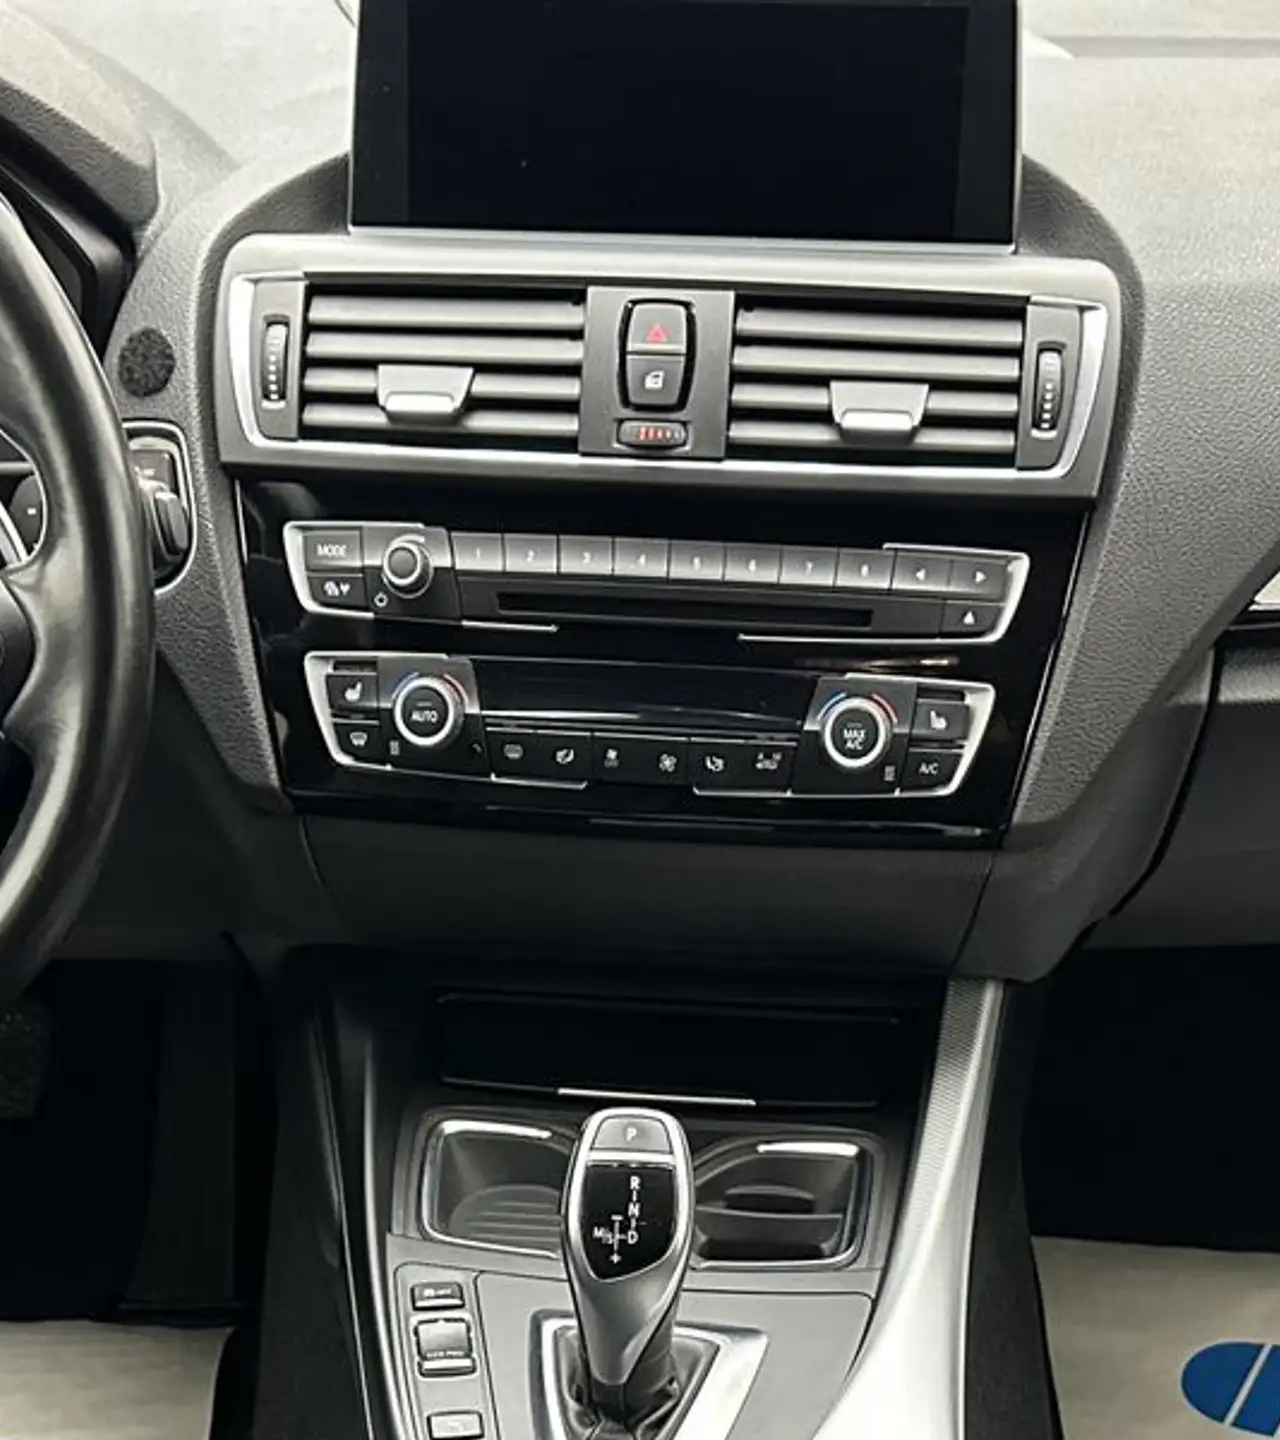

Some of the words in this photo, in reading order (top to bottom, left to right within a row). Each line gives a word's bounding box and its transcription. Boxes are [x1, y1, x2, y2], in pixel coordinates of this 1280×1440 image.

[316, 543, 347, 558] MODE
[410, 710, 438, 723] AUTO
[843, 729, 867, 741] MAX
[844, 740, 864, 751] A/C
[919, 761, 939, 776] A/C
[627, 1127, 638, 1141] P
[629, 1175, 641, 1191] R
[628, 1202, 640, 1218] N
[627, 1231, 639, 1245] D
